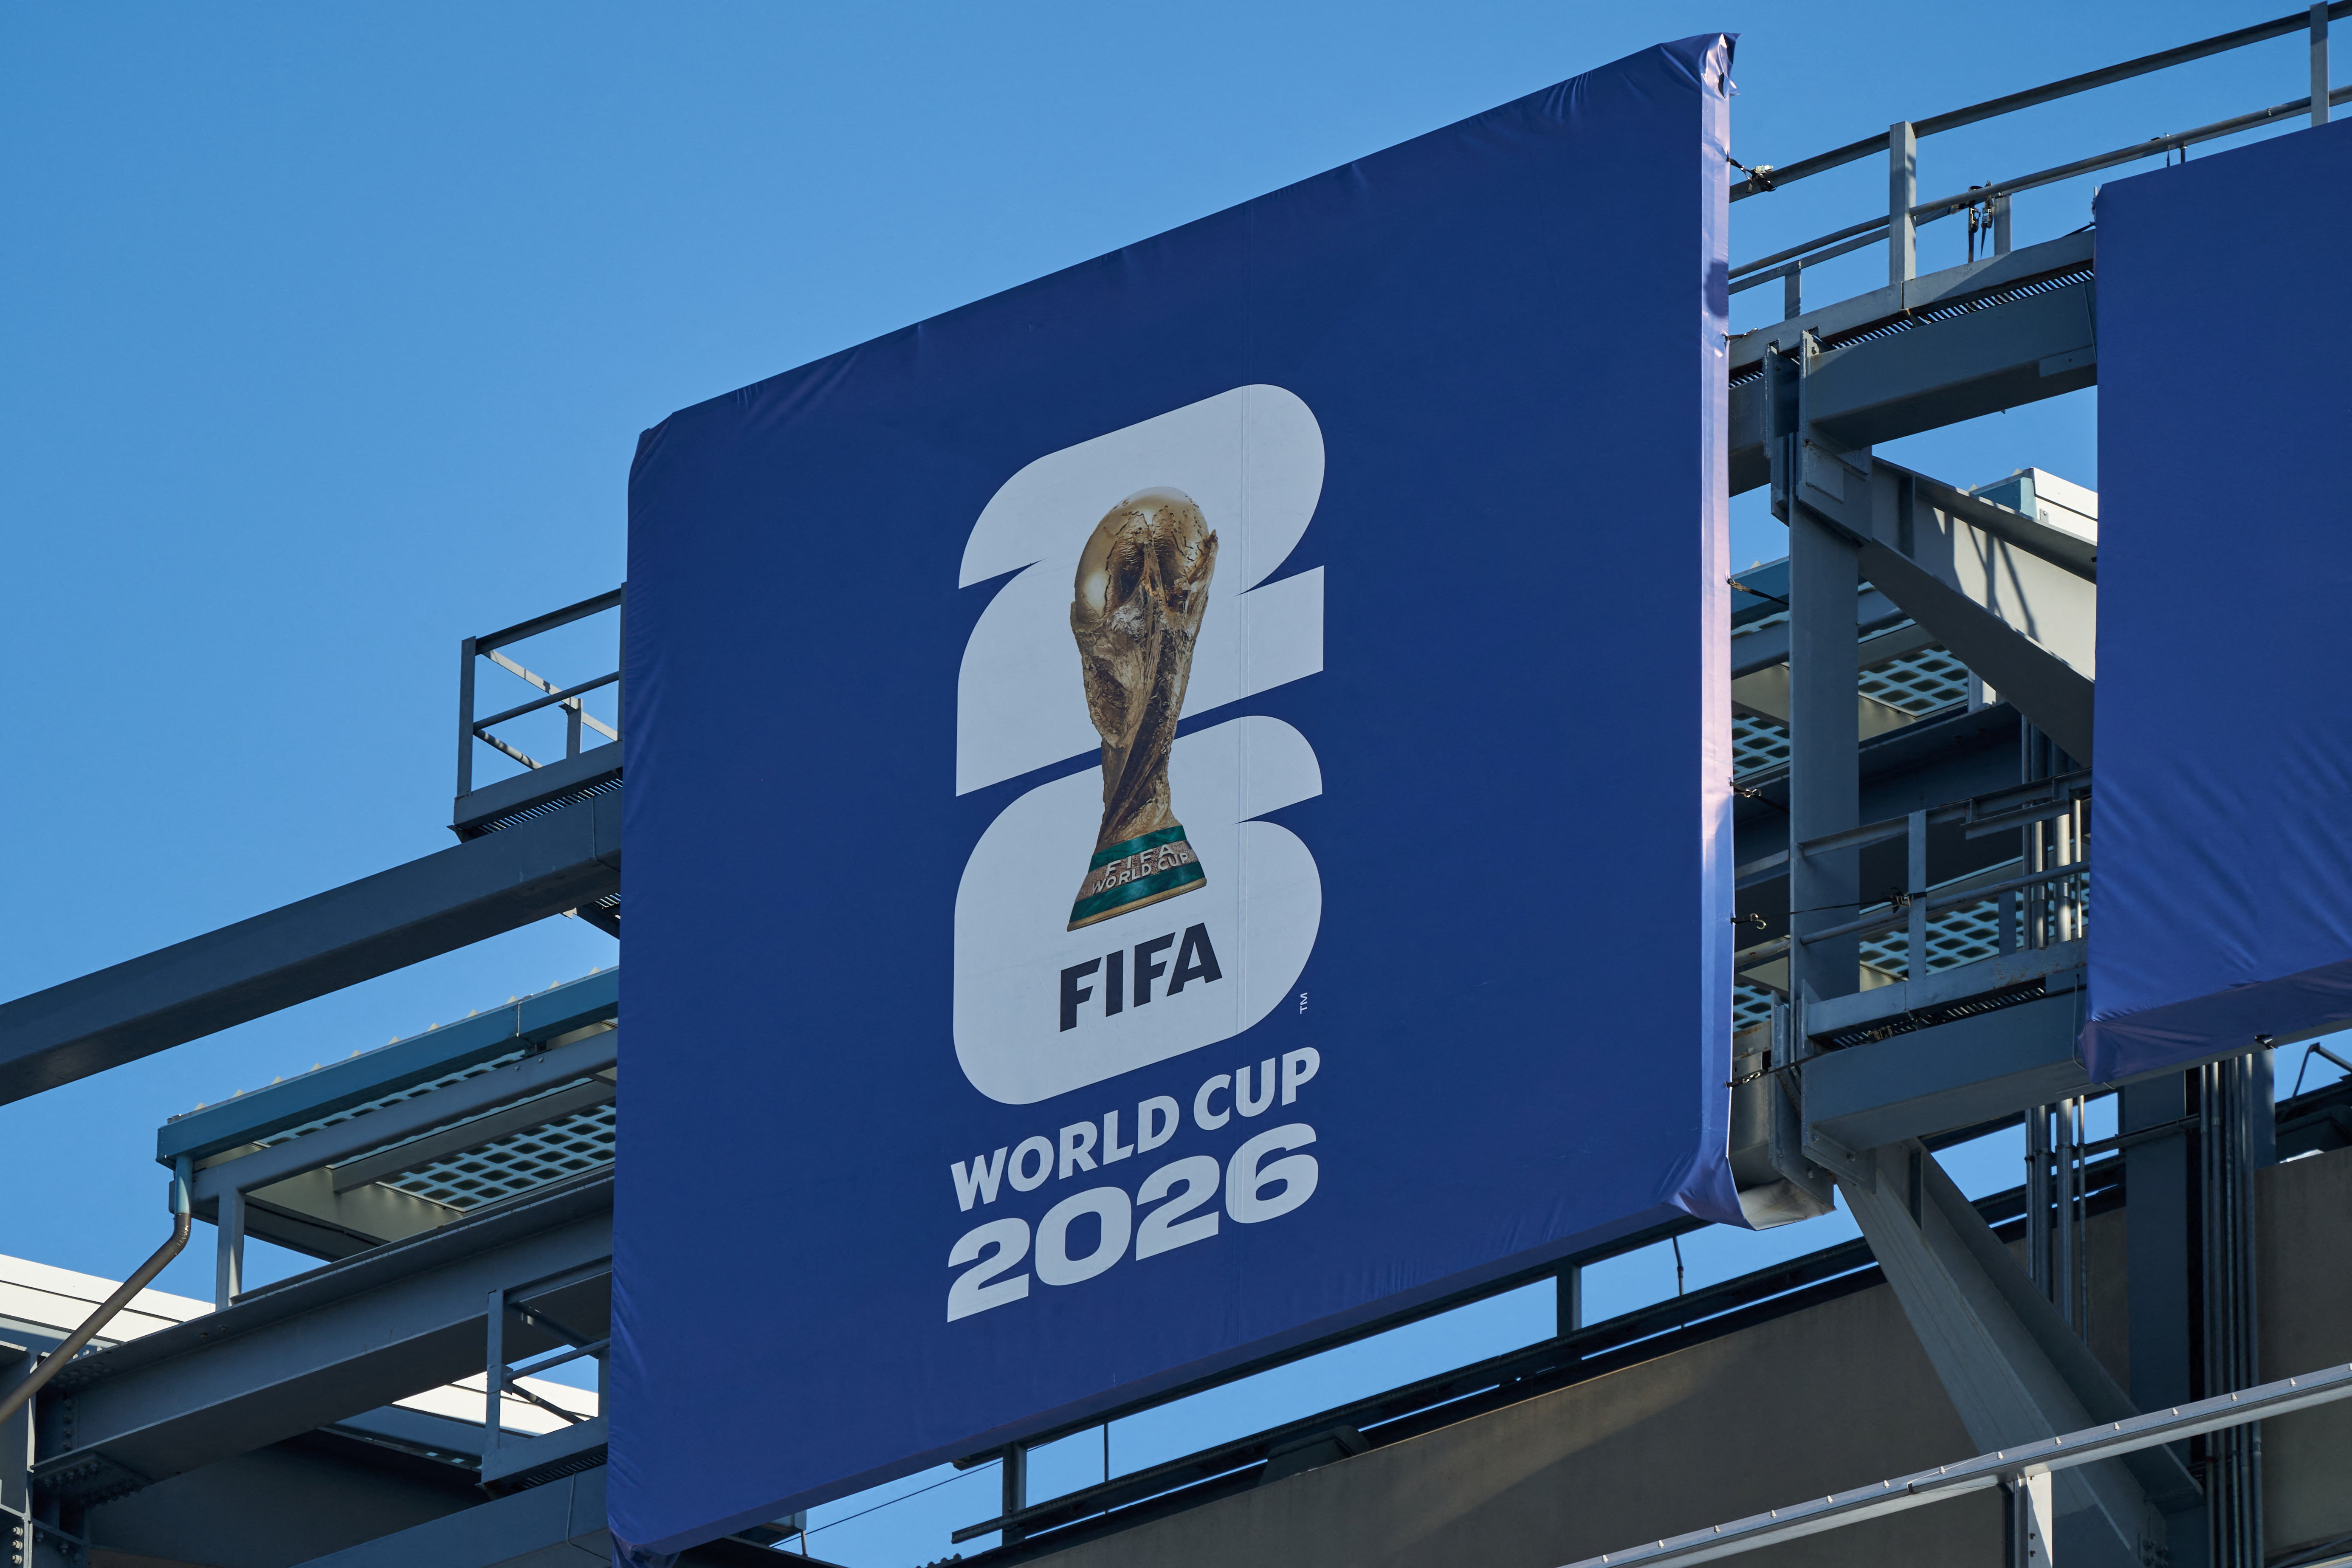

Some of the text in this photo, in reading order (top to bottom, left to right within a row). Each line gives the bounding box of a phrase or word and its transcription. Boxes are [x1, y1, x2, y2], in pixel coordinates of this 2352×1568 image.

[1092, 852, 1188, 894] WORLD CUP
[1105, 844, 1174, 877] FIFA
[1060, 922, 1222, 1032] FIFA
[951, 1047, 1320, 1212] WORLD CUP
[947, 1123, 1318, 1323] 2026
